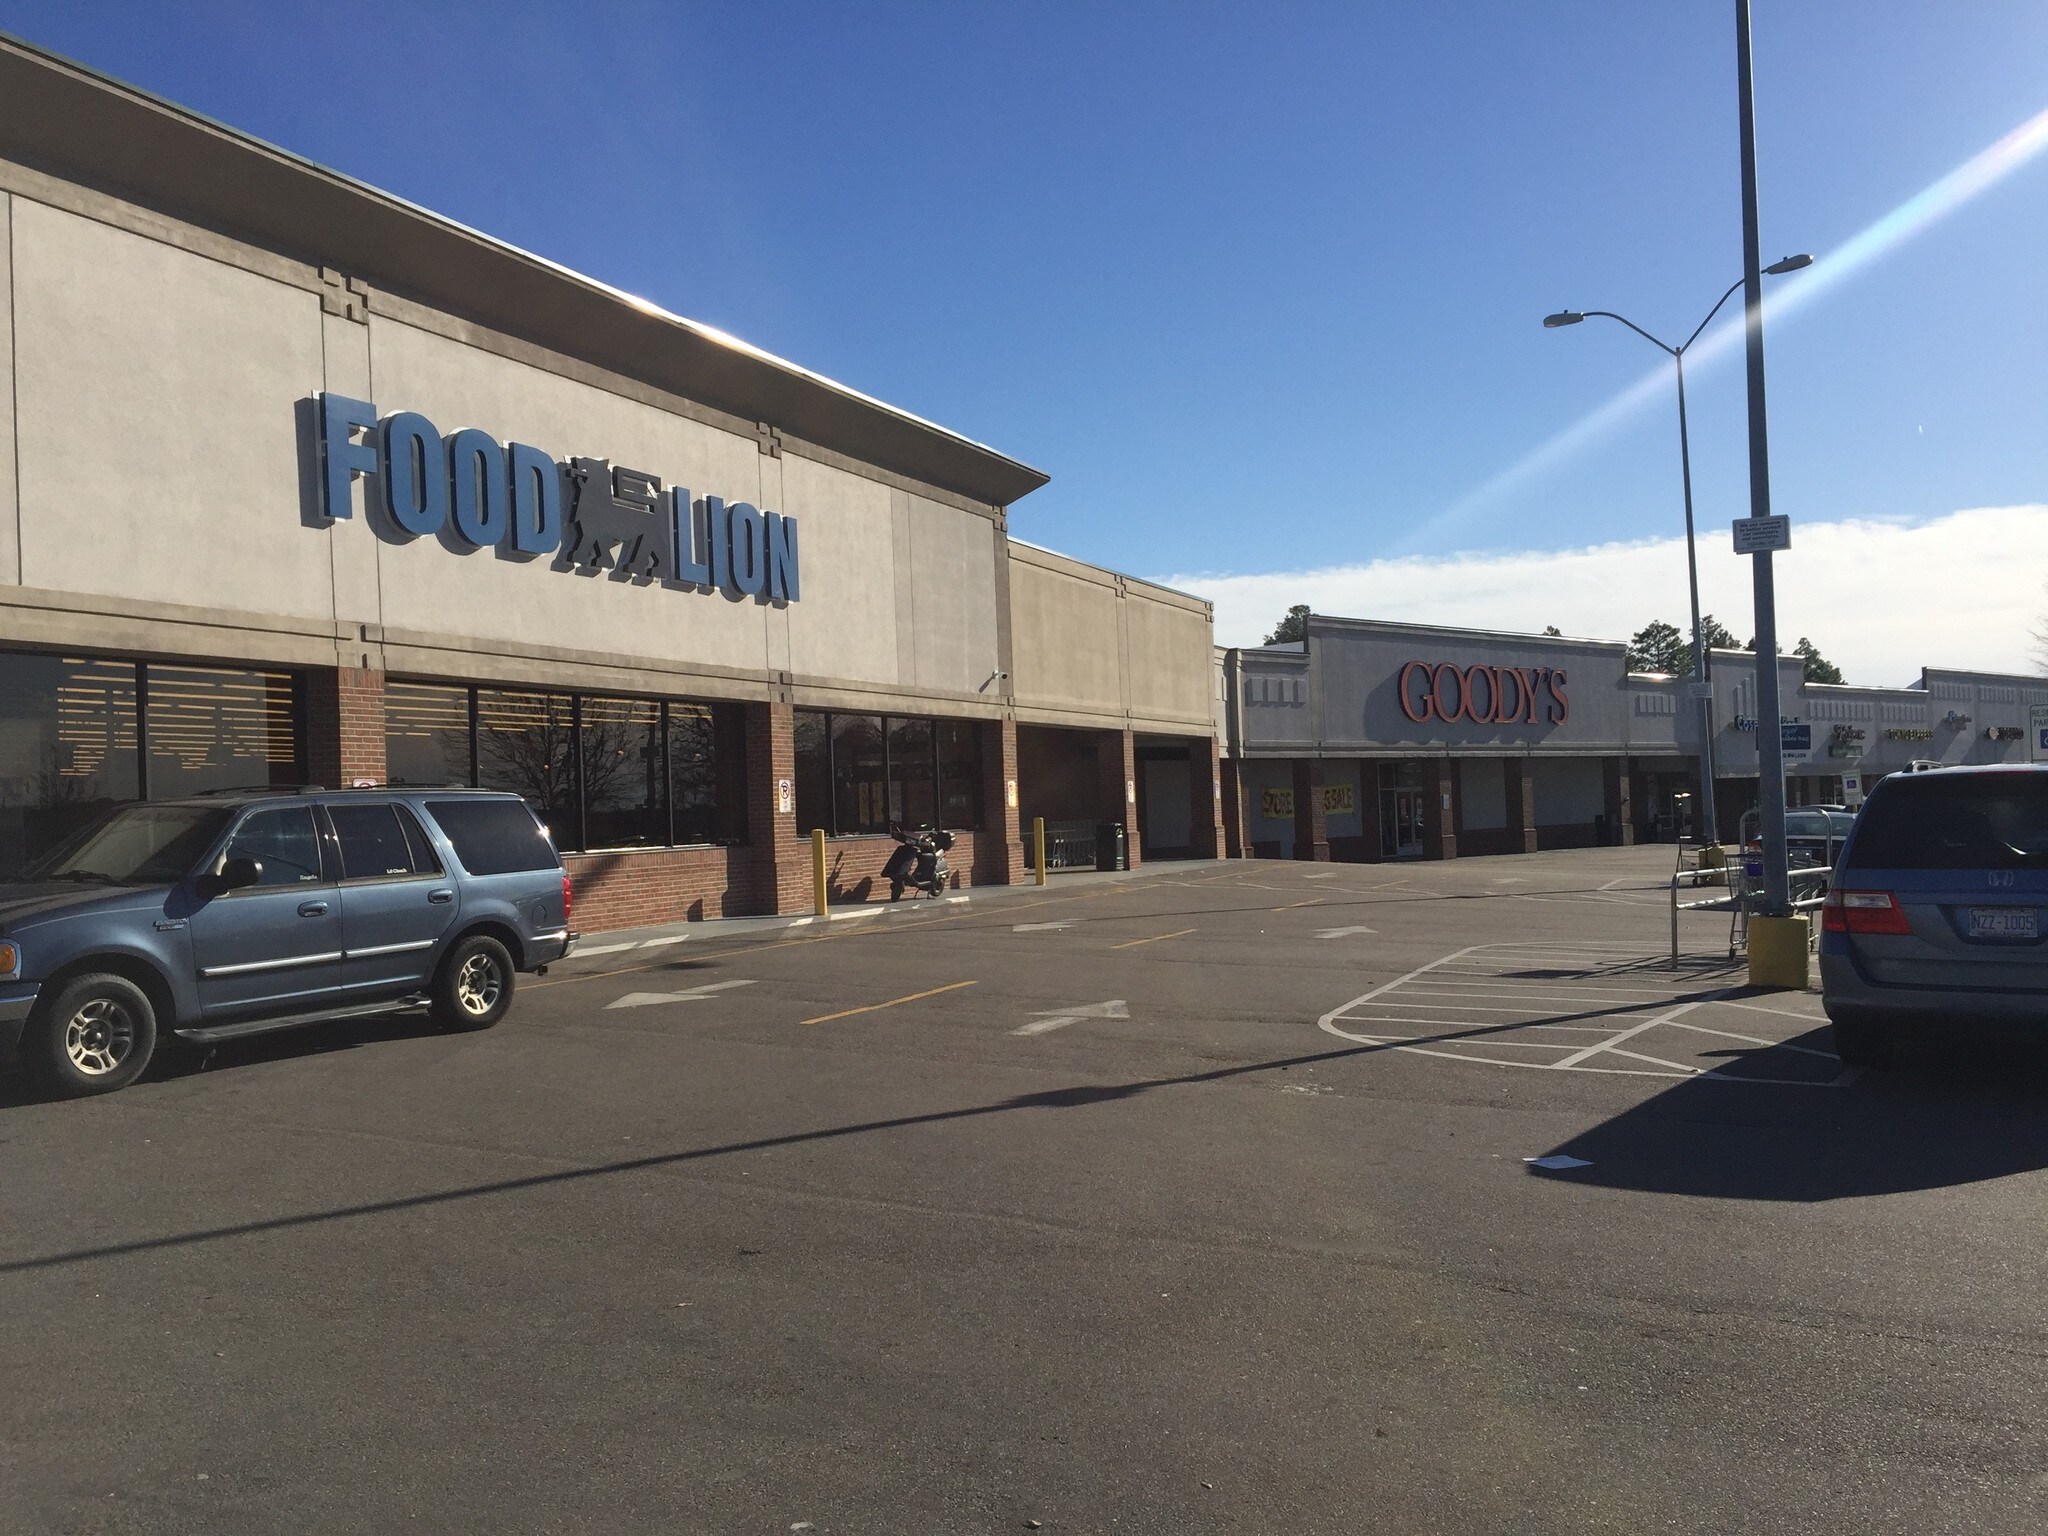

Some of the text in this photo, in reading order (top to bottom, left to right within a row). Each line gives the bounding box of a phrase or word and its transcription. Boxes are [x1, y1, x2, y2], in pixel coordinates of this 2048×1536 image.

[318, 390, 800, 602] FOOD LION
[1398, 660, 1569, 725] GOODY'S
